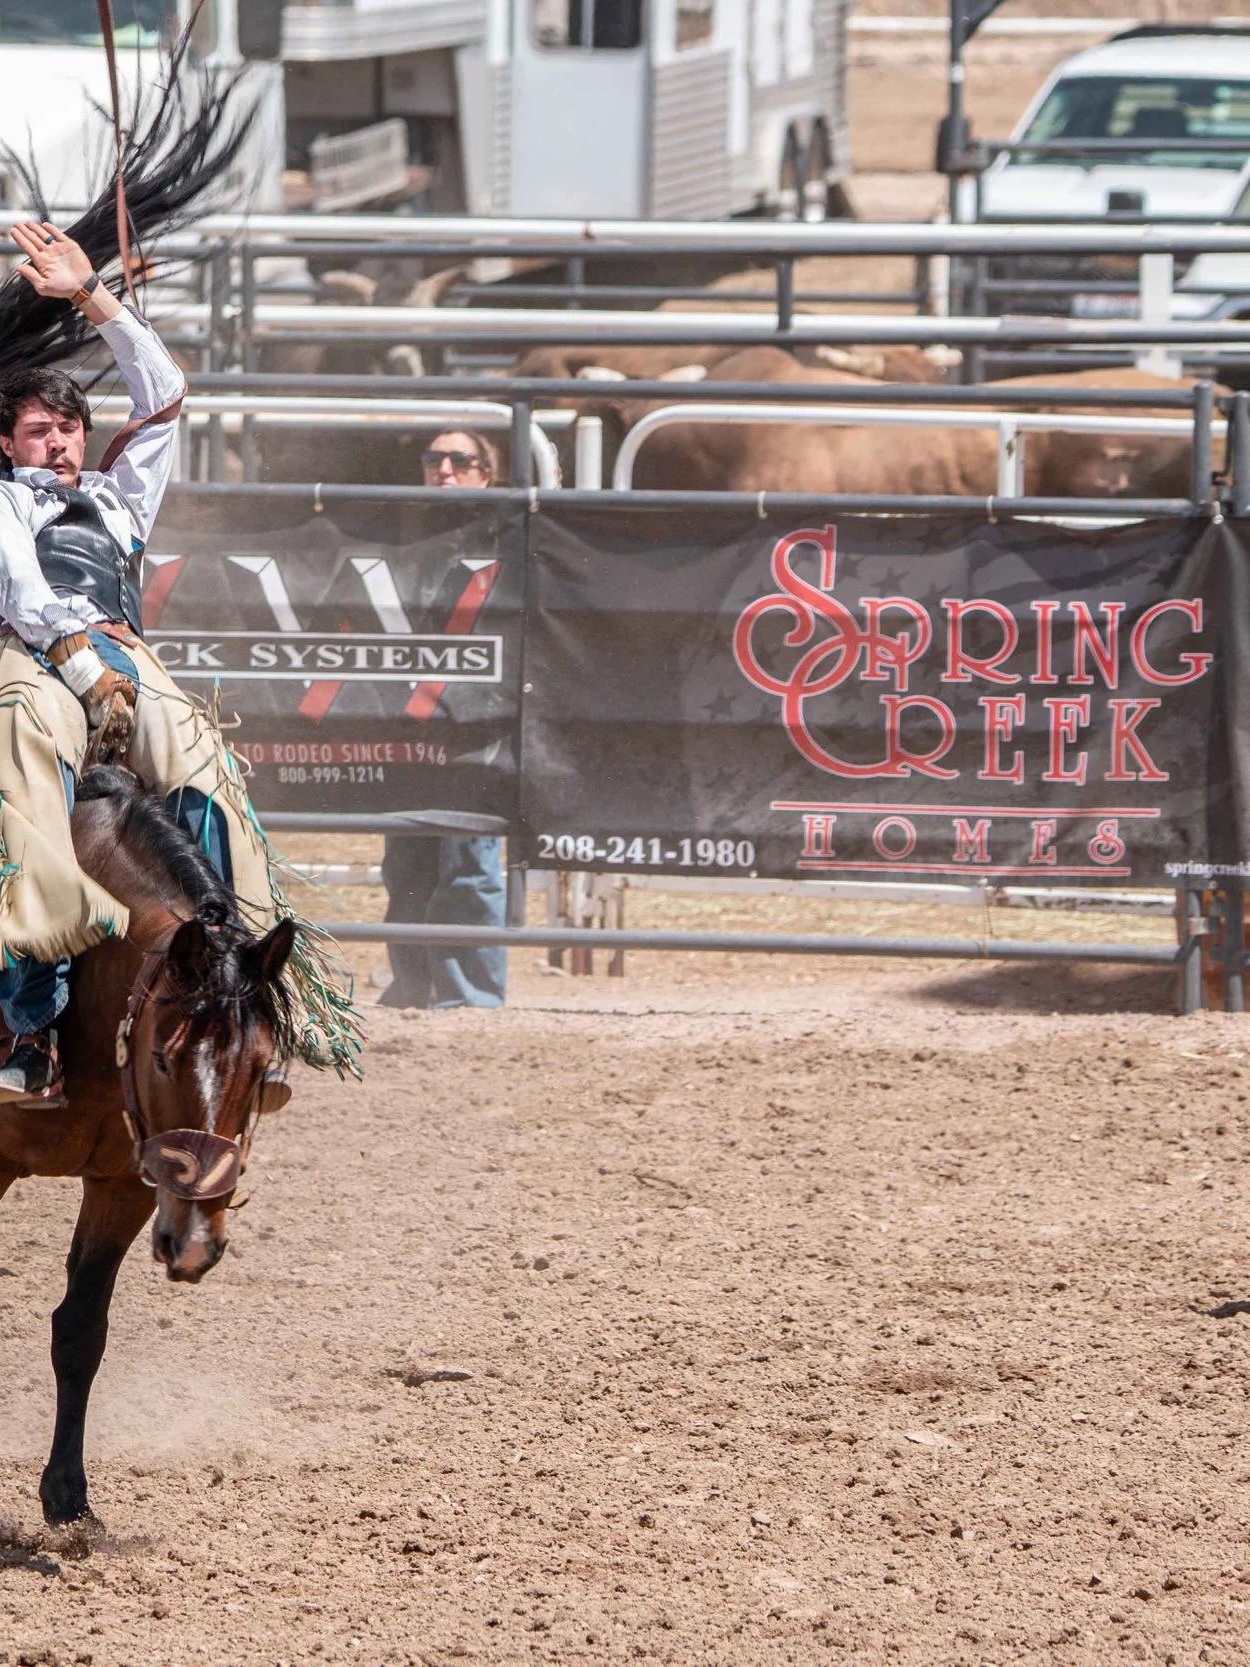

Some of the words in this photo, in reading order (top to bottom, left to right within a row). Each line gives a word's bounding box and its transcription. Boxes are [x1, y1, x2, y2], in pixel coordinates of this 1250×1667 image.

[250, 642, 490, 671] SYSTEMS
[241, 742, 264, 763] TO
[273, 743, 332, 763] RODEO
[342, 743, 395, 763] SINCE
[404, 742, 447, 766] 1946
[278, 766, 385, 784] 800-999-1214
[537, 834, 756, 868] 208-241-1980
[801, 814, 1126, 865] HOMES
